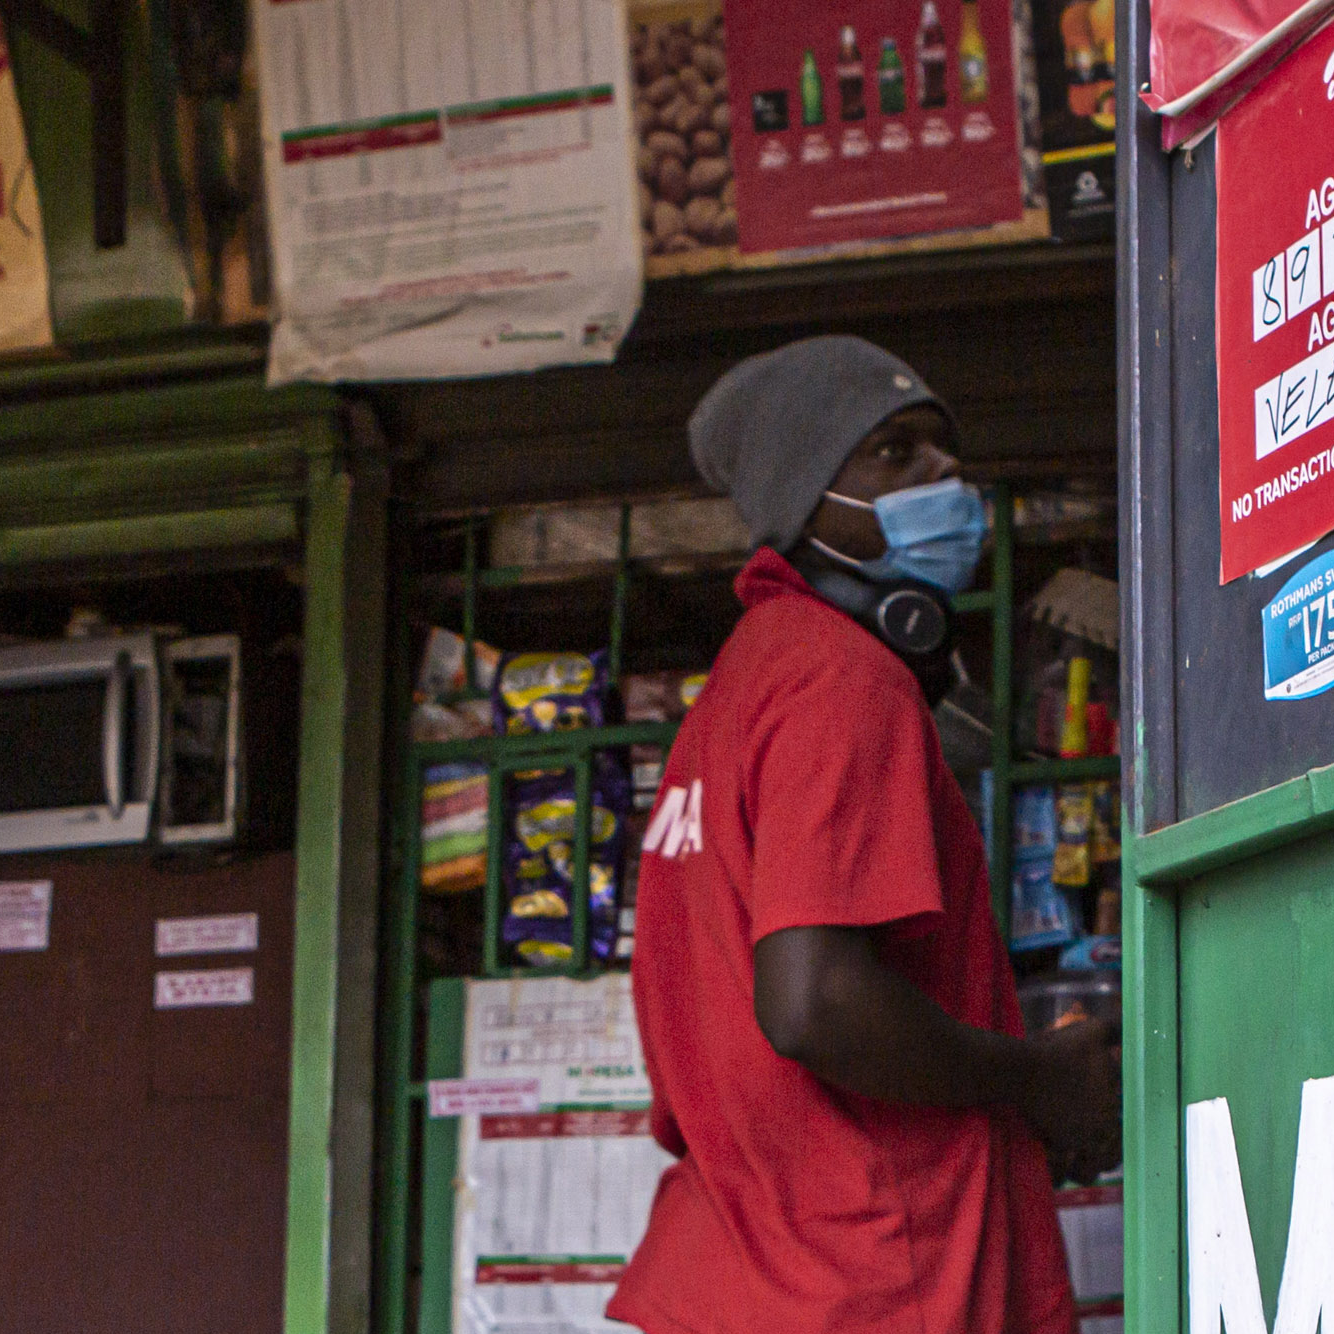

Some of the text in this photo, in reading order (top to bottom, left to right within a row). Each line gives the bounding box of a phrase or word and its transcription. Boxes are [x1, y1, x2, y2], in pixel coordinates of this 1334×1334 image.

[1232, 492, 1253, 523] NO
[1270, 575, 1324, 619] ROTHMANS
[1307, 649, 1320, 664] PER
